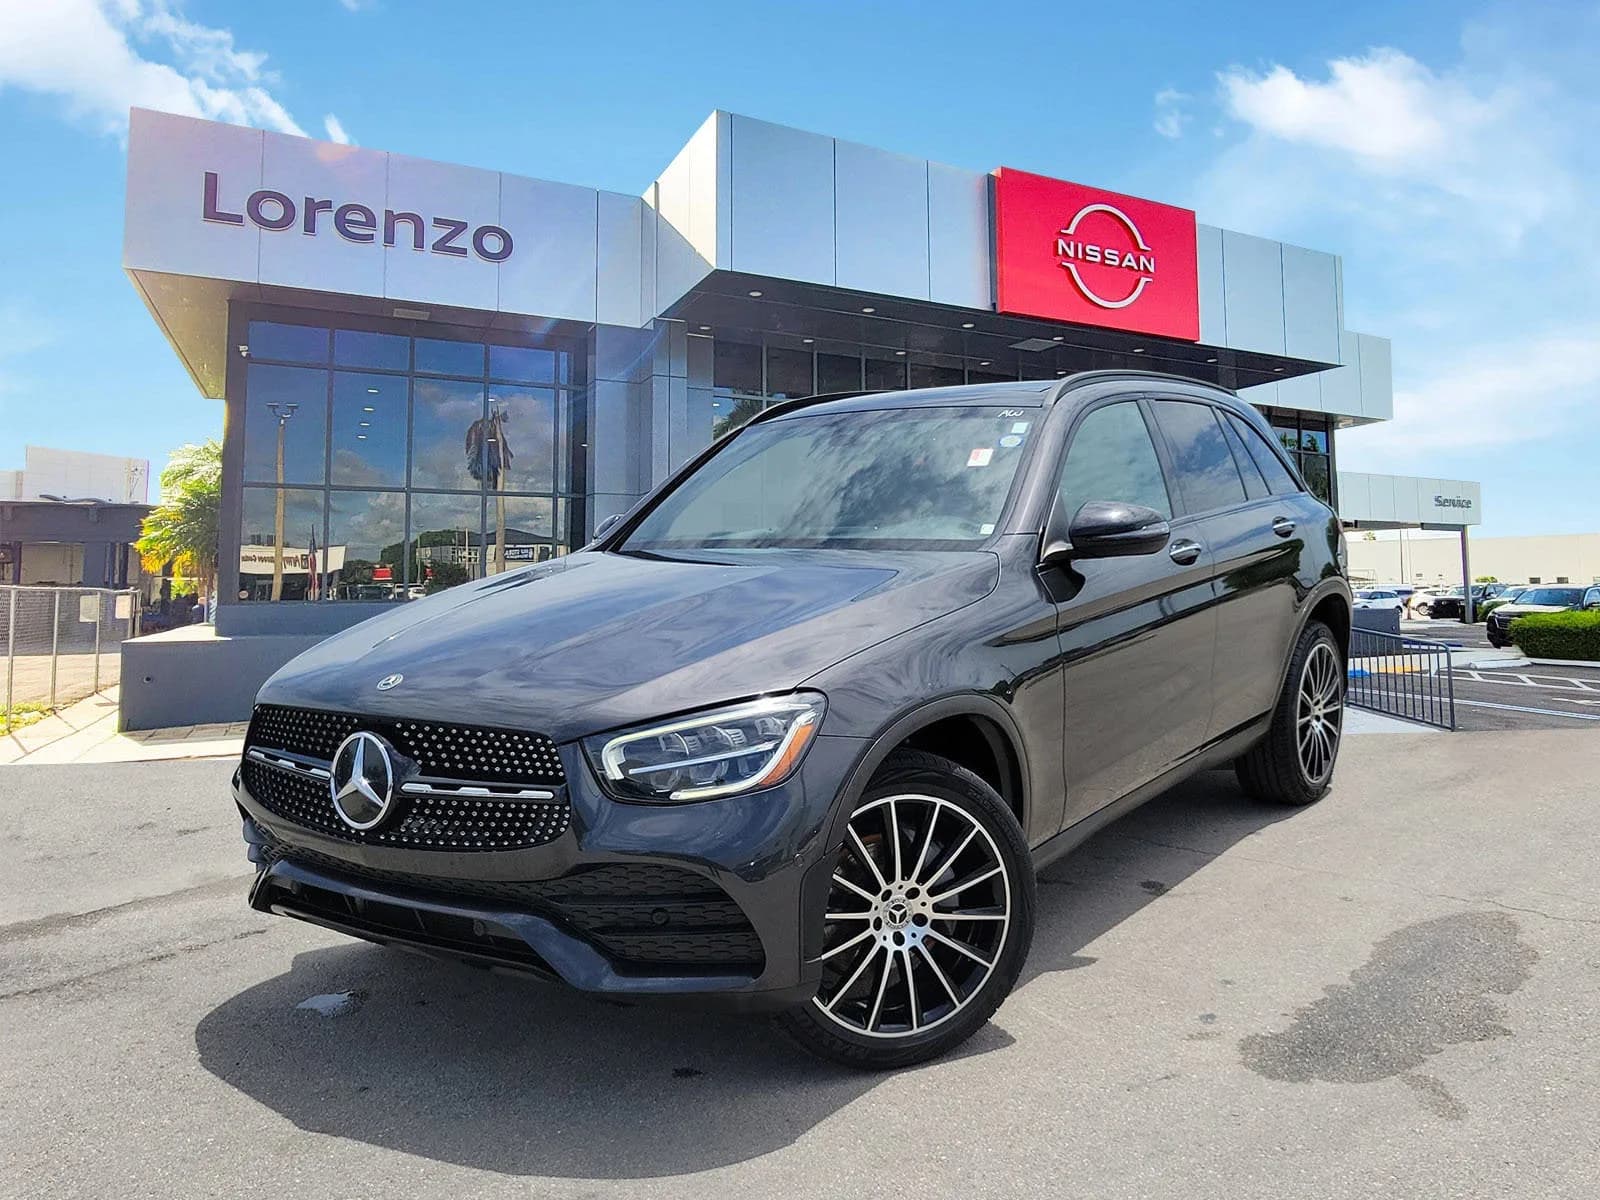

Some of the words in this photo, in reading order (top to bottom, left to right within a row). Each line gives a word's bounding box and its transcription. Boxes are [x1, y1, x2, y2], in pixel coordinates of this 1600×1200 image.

[203, 171, 514, 262] Lorenzo
[1058, 238, 1155, 273] NISSAN
[1434, 495, 1472, 509] Service
